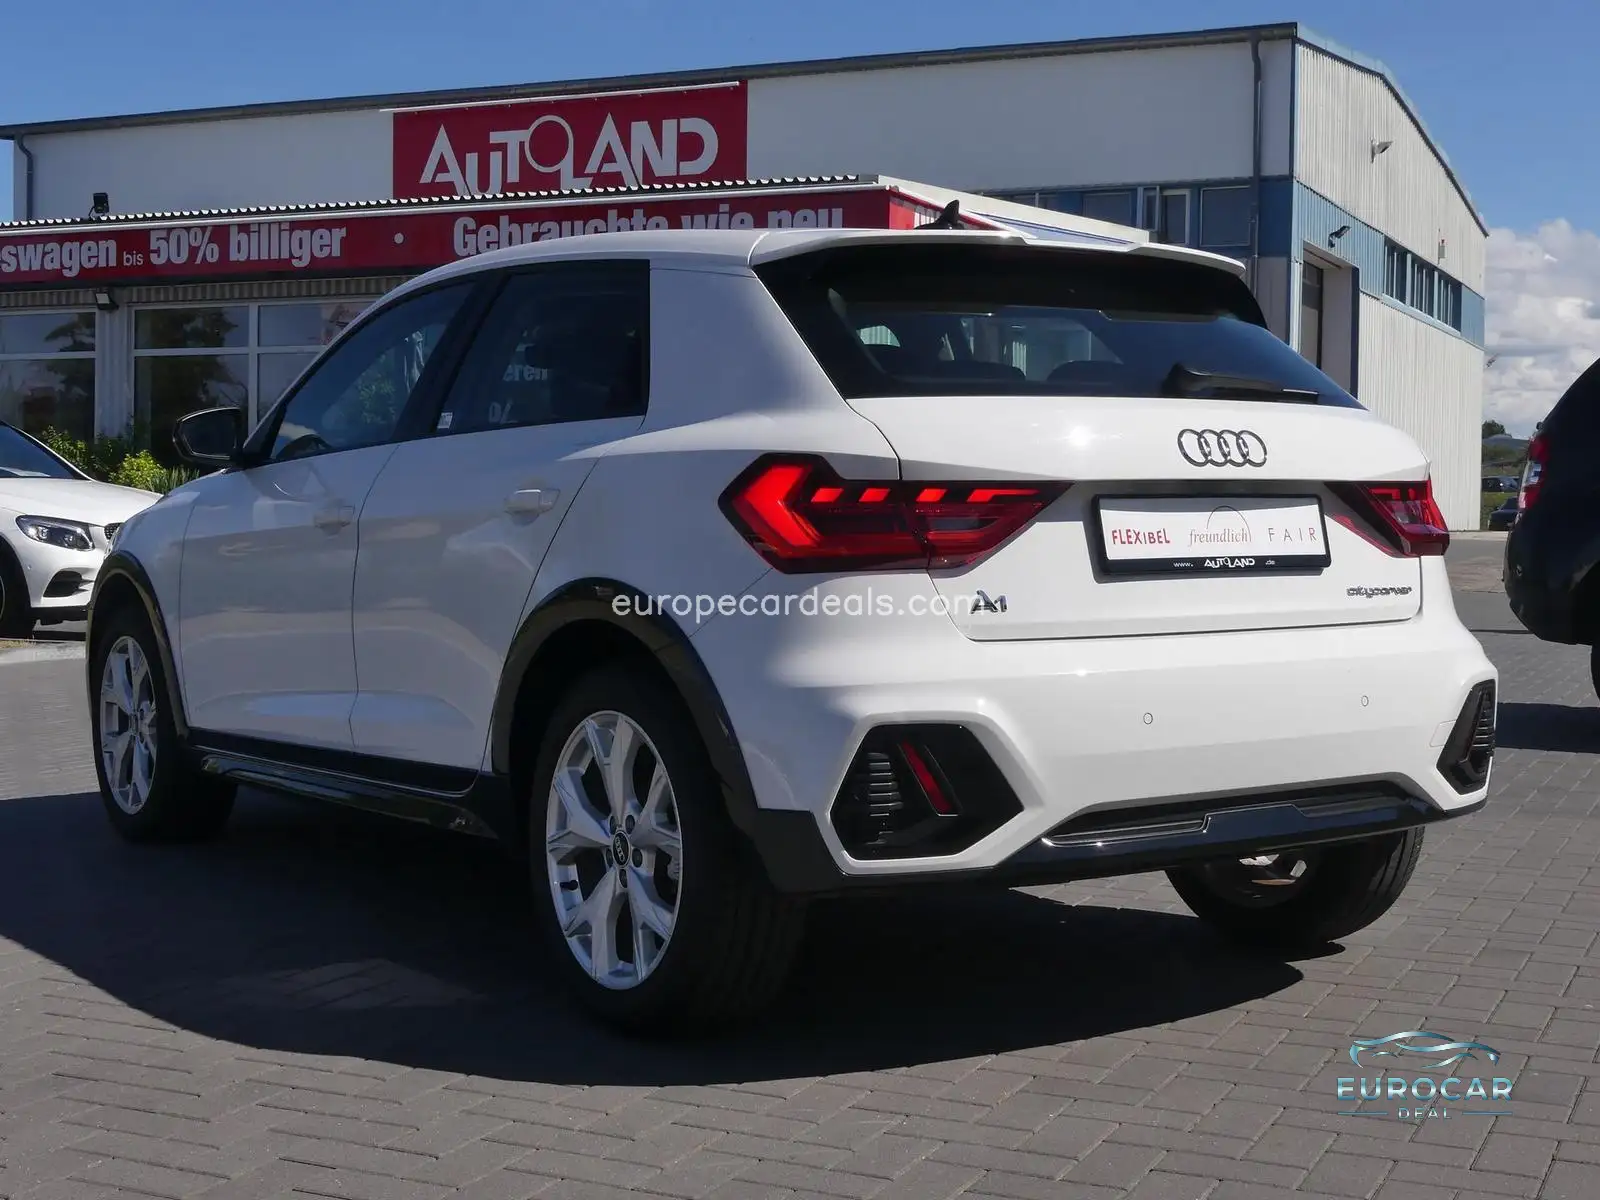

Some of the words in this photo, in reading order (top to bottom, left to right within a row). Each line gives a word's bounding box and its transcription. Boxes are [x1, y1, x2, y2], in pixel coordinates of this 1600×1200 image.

[419, 112, 719, 196] AUTOLAND
[122, 250, 144, 267] bis
[149, 227, 220, 265] 50%
[229, 222, 347, 268] billiger
[1111, 527, 1171, 546] FLEXIBEL
[1187, 527, 1248, 548] freundlich
[1268, 527, 1318, 543] FAIR
[1204, 556, 1256, 569] AUTOLAND
[970, 589, 1008, 614] A1
